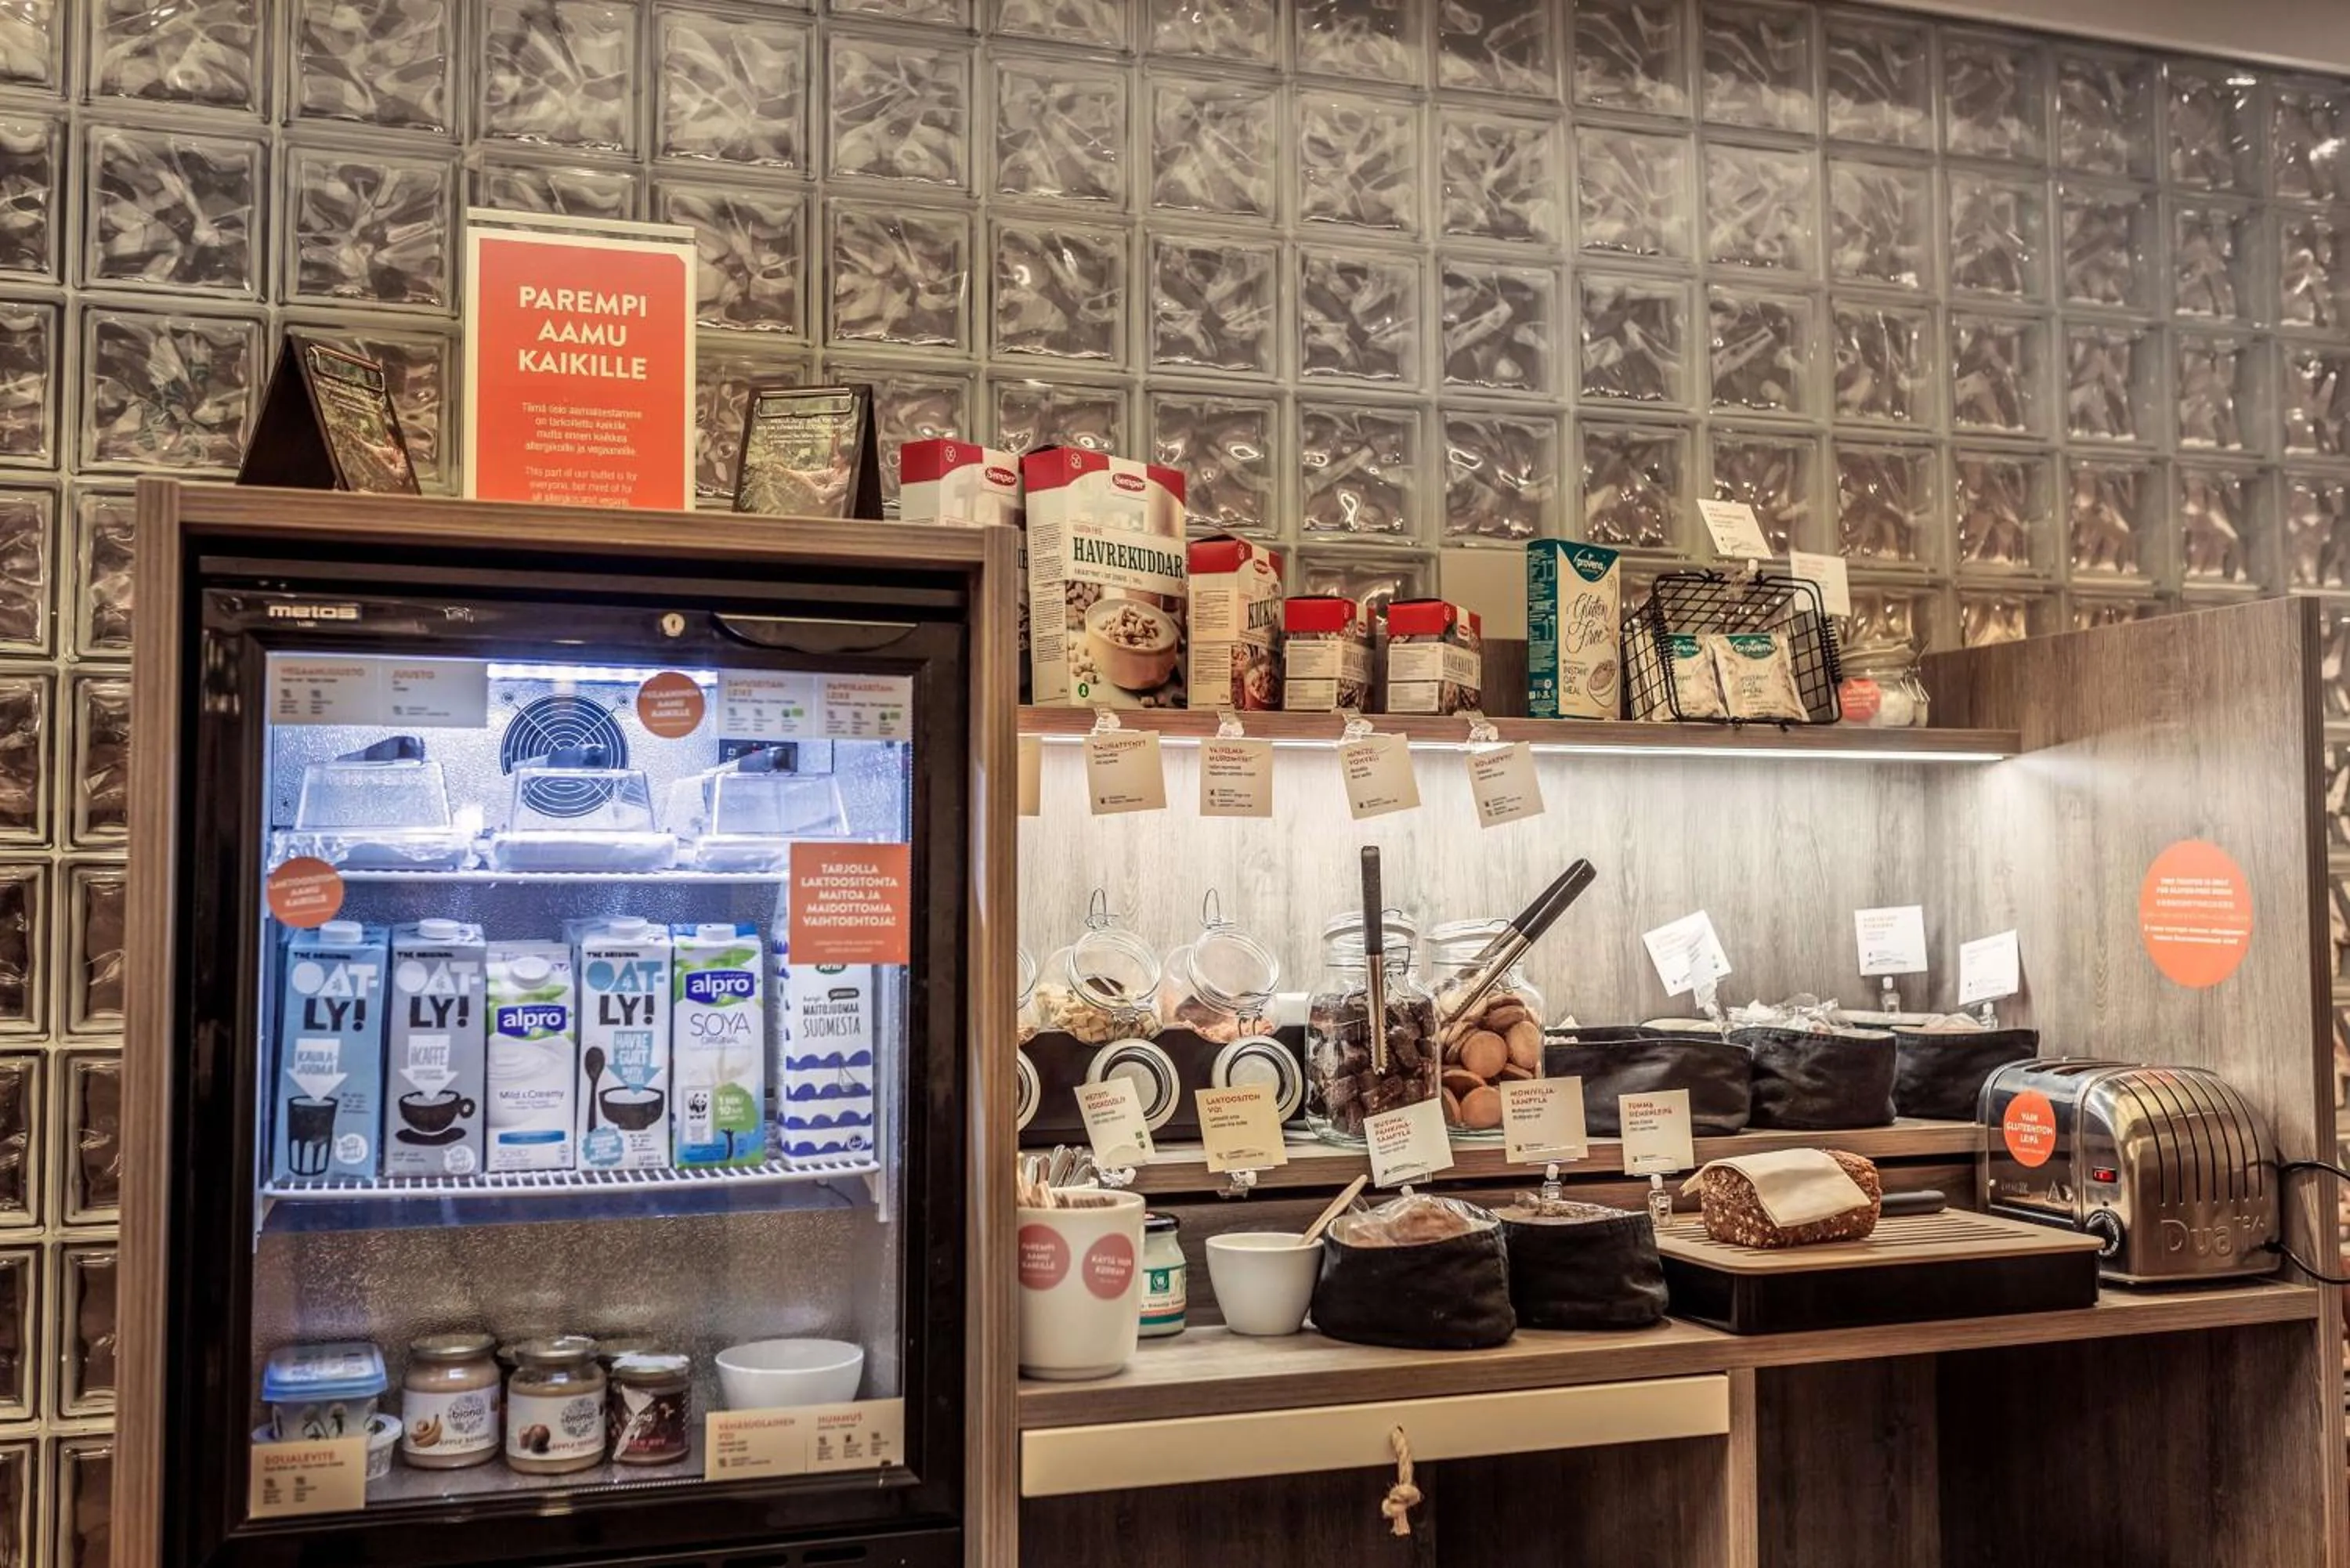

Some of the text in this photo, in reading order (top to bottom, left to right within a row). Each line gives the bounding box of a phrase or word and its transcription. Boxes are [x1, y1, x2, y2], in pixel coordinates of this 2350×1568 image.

[519, 285, 647, 317] PAREMPI
[538, 318, 627, 347] AAMU
[518, 349, 648, 380] KAIKILLE
[1114, 475, 1144, 491] Semper
[1072, 537, 1184, 579] HAVREKUDDAR
[269, 605, 359, 620] metos
[1567, 593, 1608, 623] Gluten
[1565, 621, 1611, 654] Free
[801, 876, 898, 887] LAKTOOSITONTA
[821, 864, 879, 875] TARJOLLA
[819, 890, 865, 900] MAITOA
[805, 903, 893, 914] MAIDOTTOMIA
[691, 974, 750, 999] alpro
[303, 997, 367, 1032] LY!
[410, 995, 469, 1028] LY!
[503, 1007, 562, 1032] alpro
[599, 994, 655, 1026] LY!
[690, 1012, 751, 1036] SOYA
[803, 1017, 861, 1039] SUOMESTA
